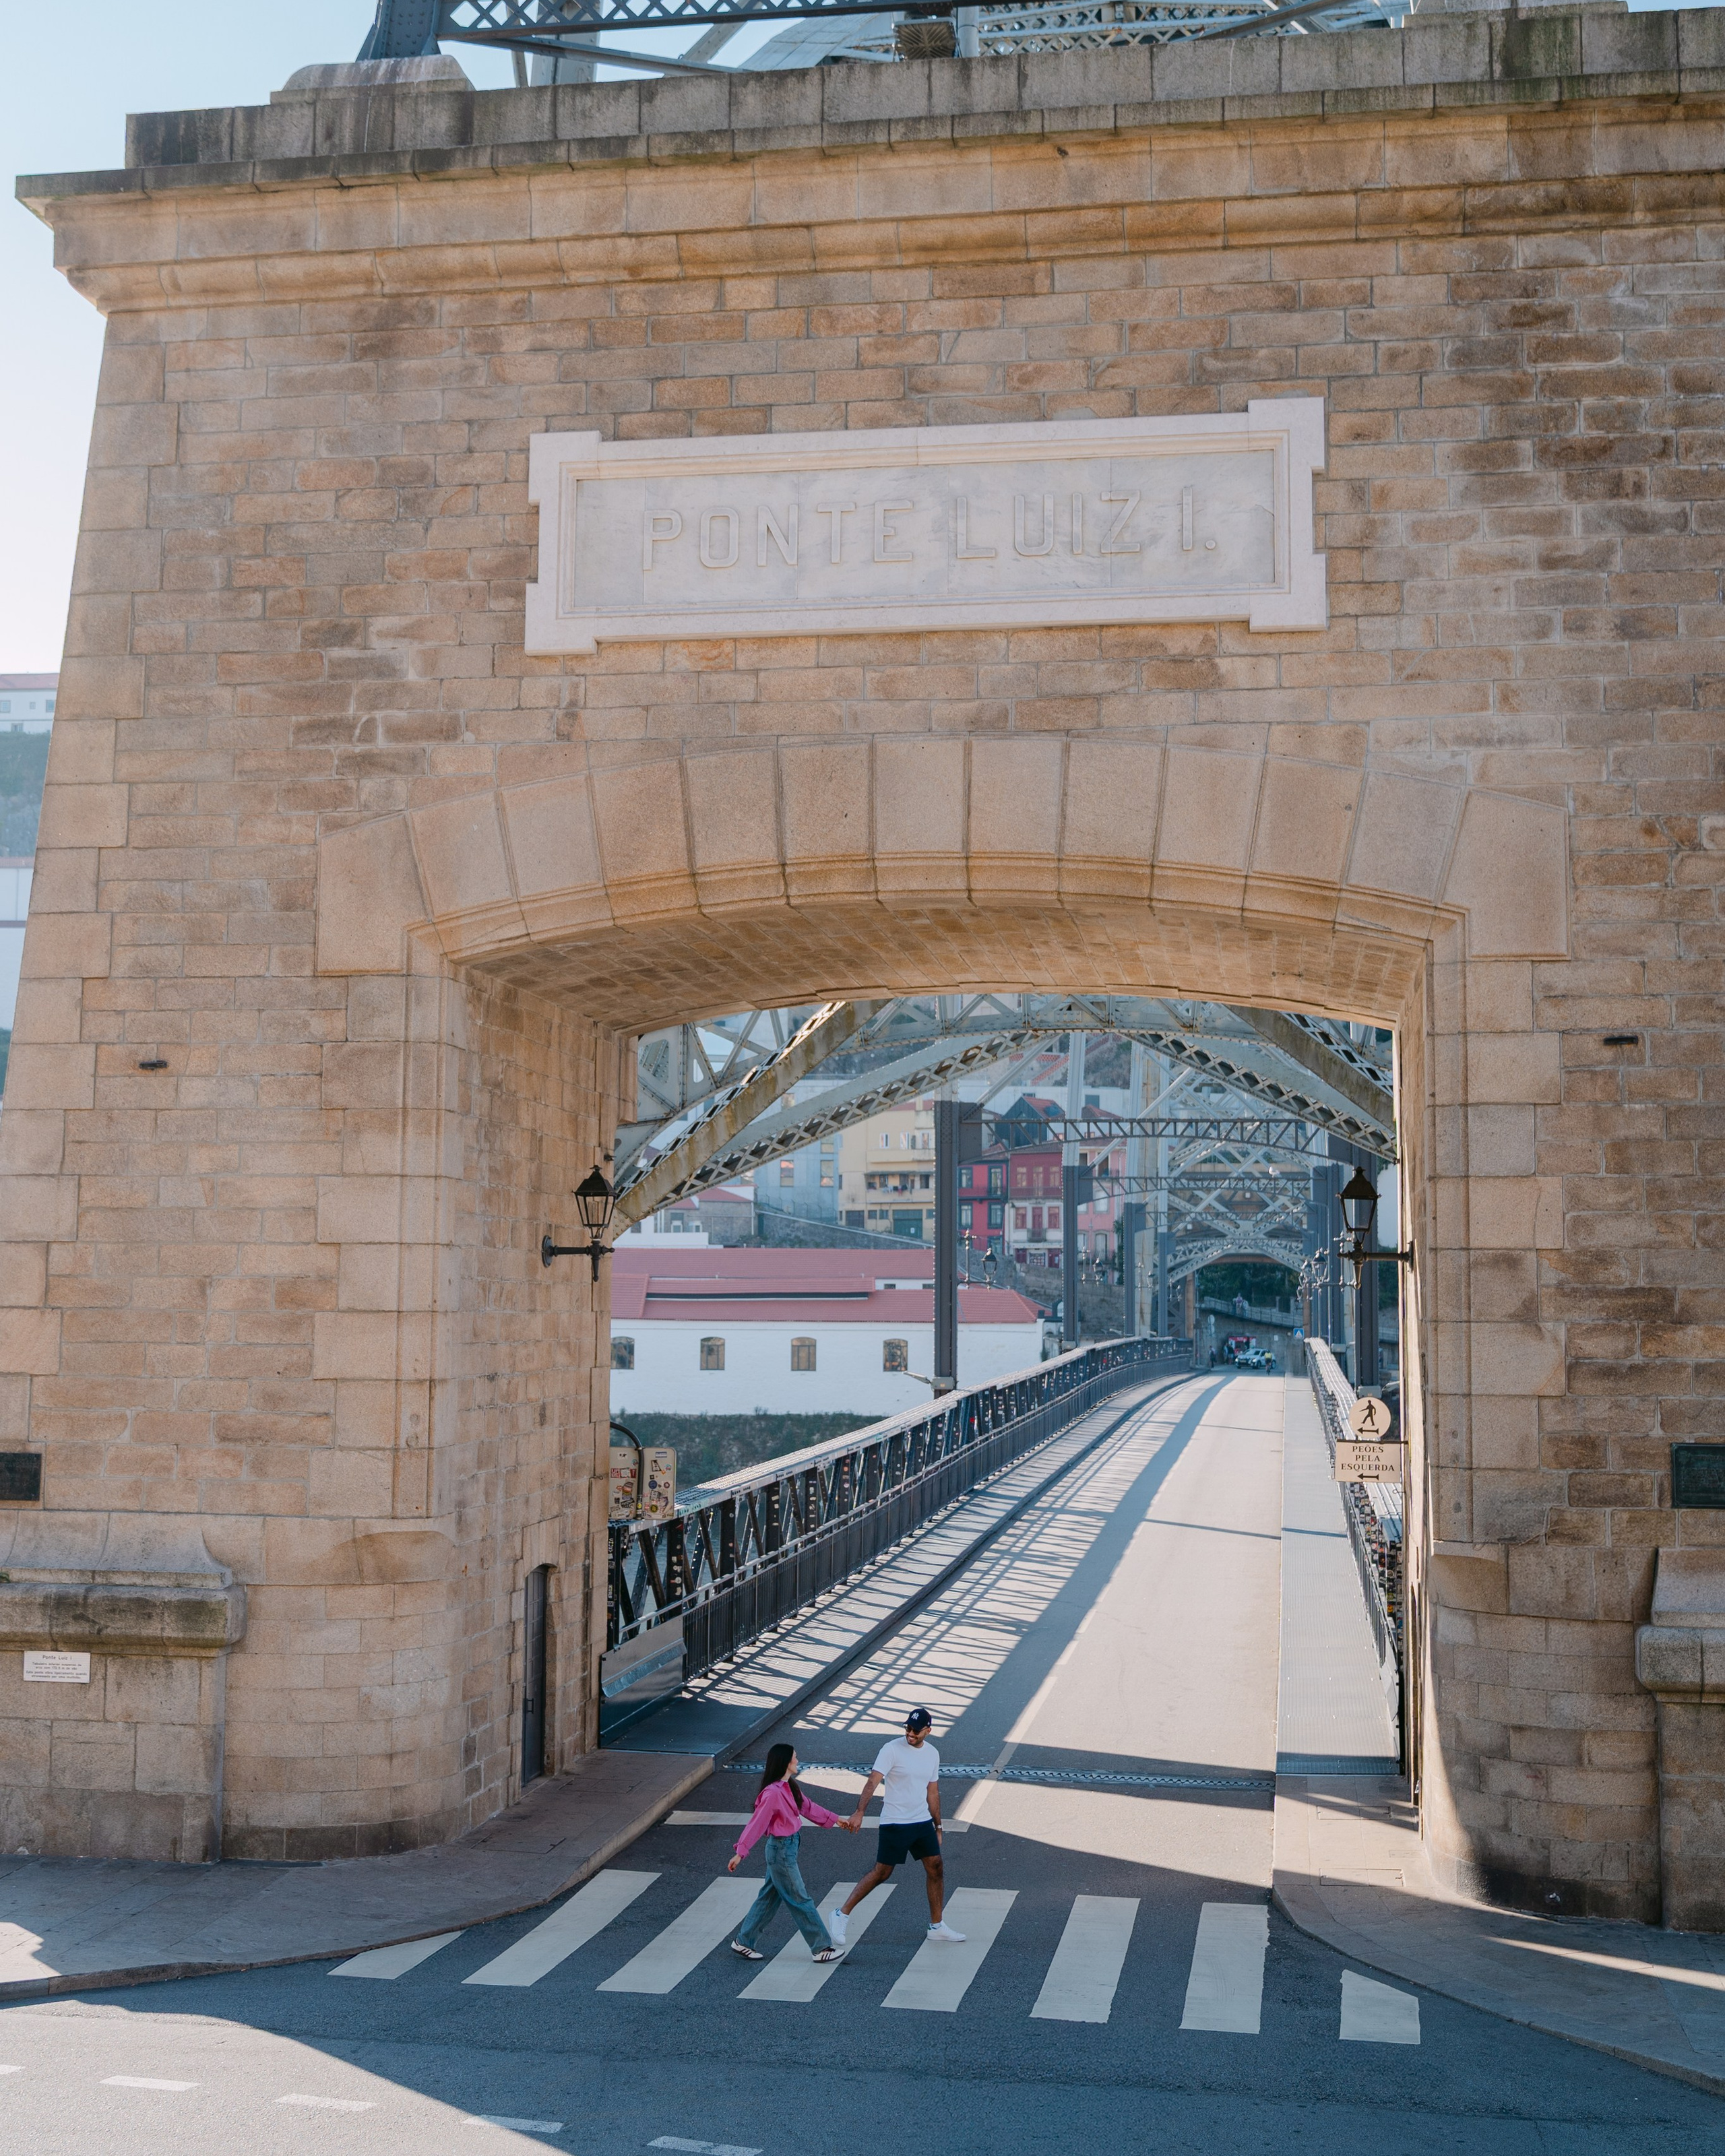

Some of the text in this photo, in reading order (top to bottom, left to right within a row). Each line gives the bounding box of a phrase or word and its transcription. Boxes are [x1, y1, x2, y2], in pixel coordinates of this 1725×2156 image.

[643, 487, 1216, 571] PONTE LUIZ I.
[1352, 1445, 1384, 1453] PEÕES
[1341, 1463, 1395, 1471] ESQUERDA
